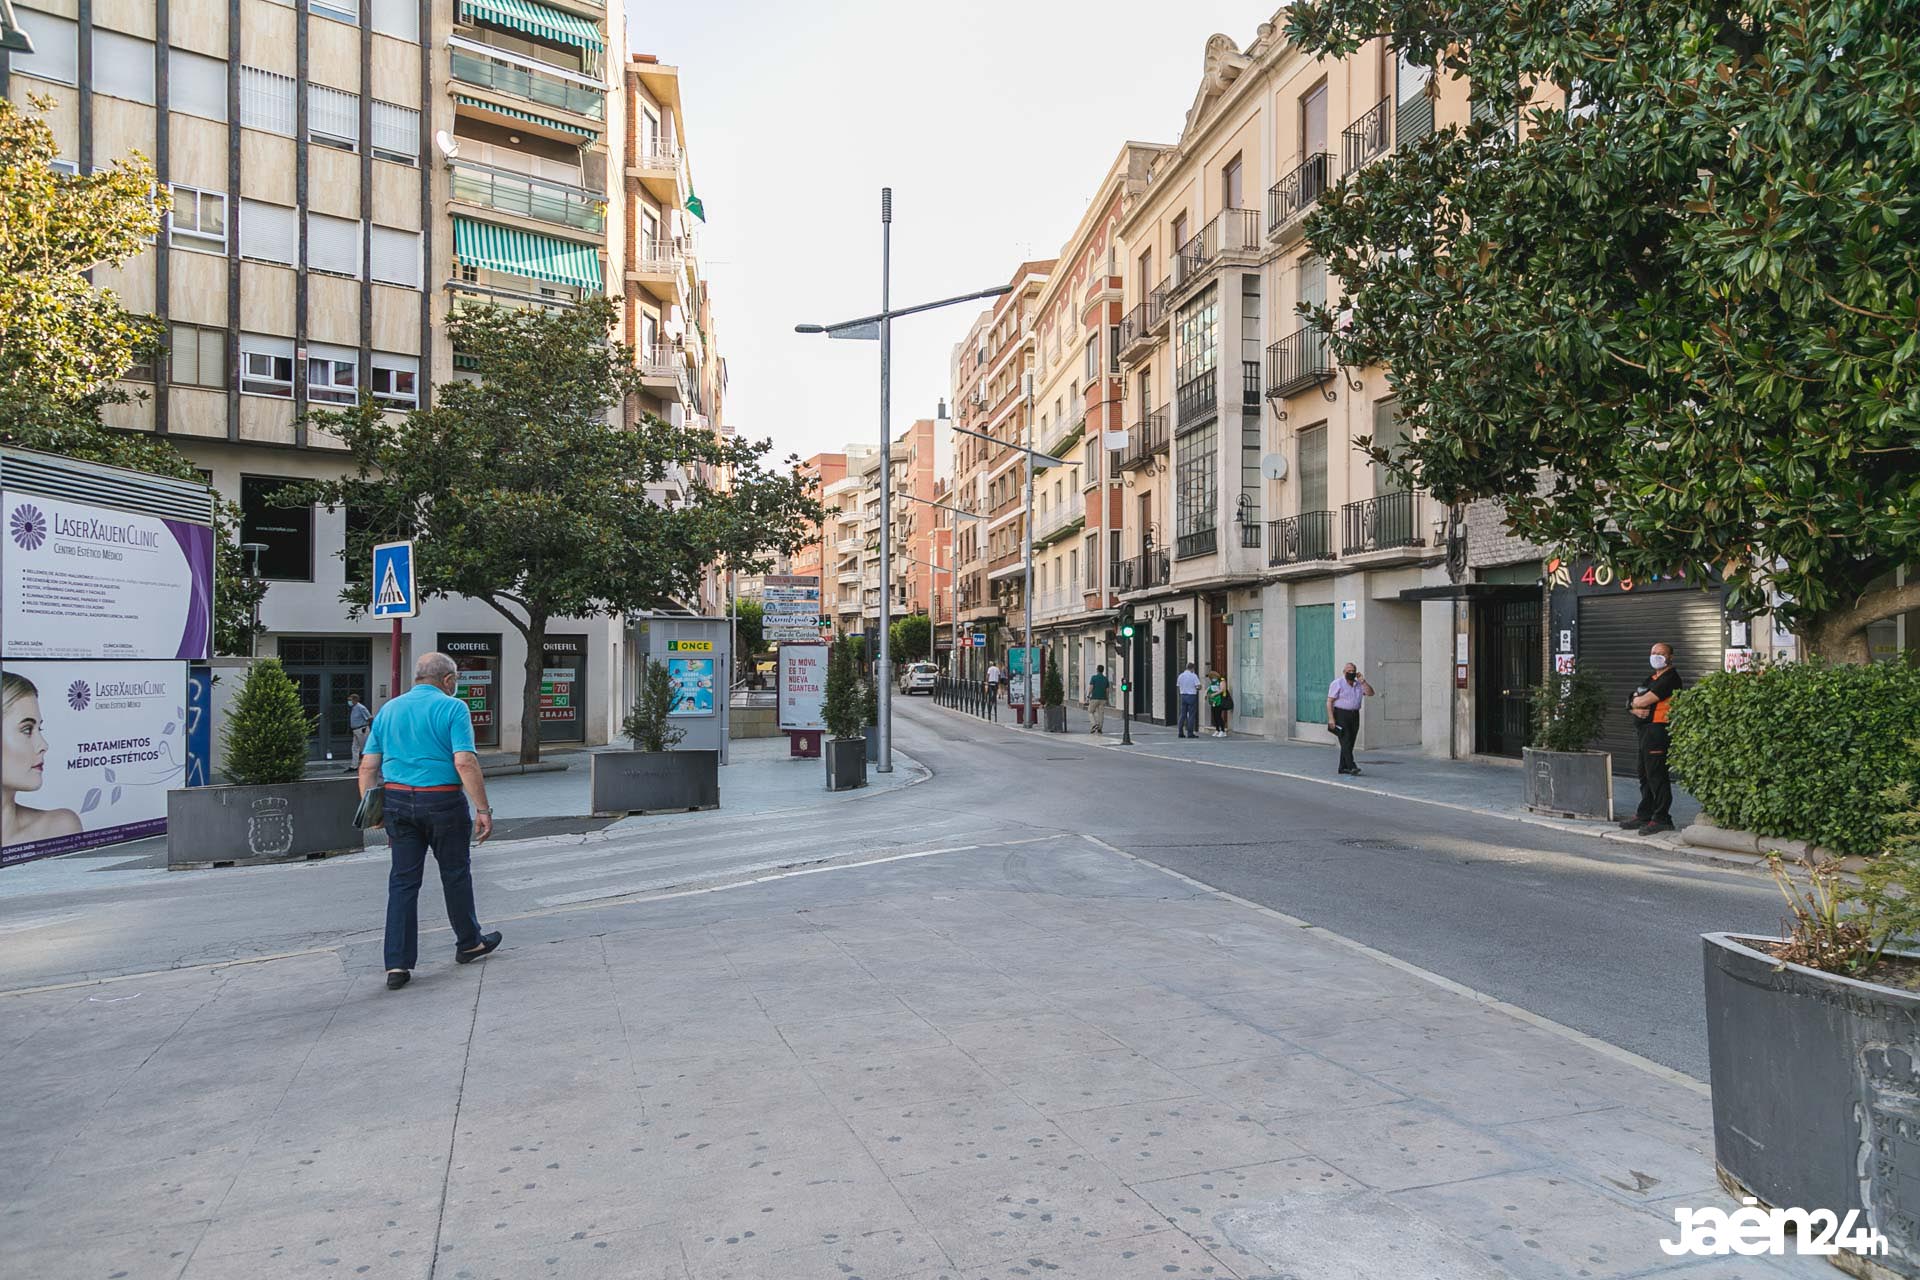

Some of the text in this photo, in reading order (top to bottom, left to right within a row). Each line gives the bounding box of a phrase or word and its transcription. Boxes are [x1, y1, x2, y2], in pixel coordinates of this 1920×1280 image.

[447, 642, 490, 651] CORTEFIEL
[543, 642, 577, 651] ORTEFIEL
[681, 642, 709, 650] ONCE
[788, 658, 796, 666] TU
[77, 737, 151, 753] TRATAMIENTOS
[66, 750, 159, 770] MÉDICO-ESTÉTICOS
